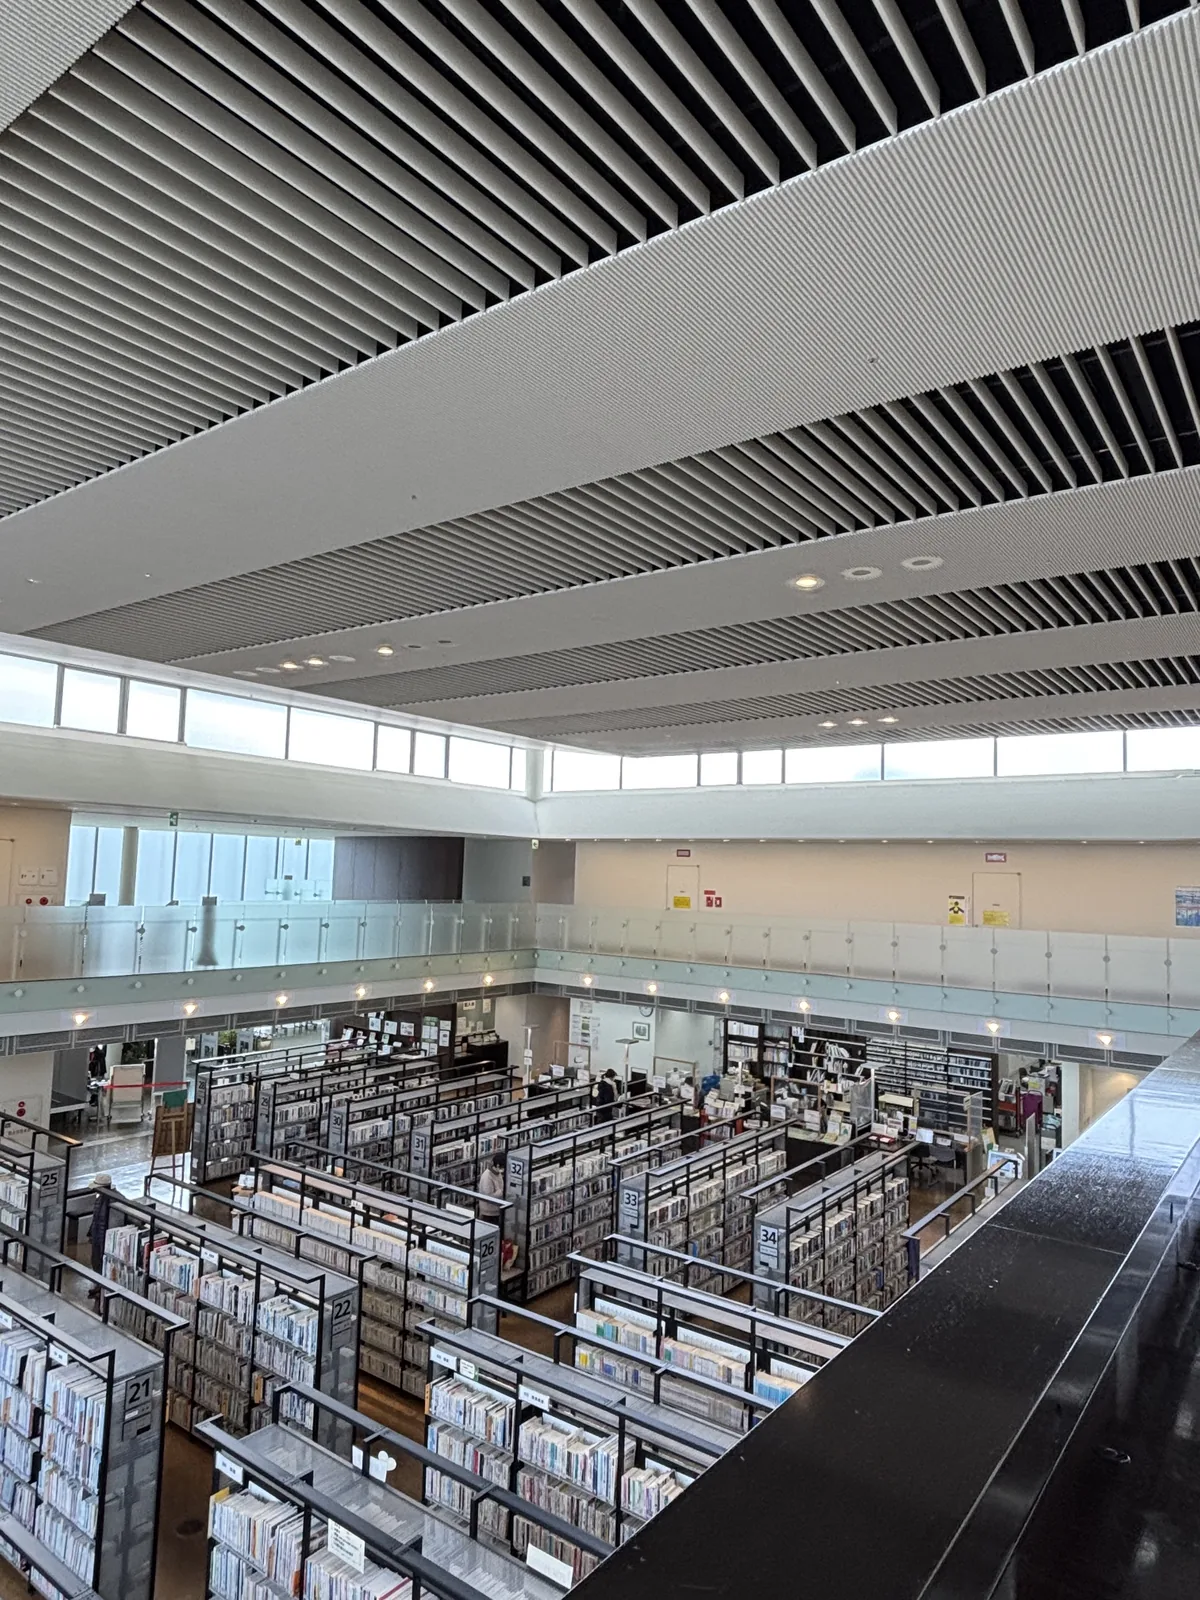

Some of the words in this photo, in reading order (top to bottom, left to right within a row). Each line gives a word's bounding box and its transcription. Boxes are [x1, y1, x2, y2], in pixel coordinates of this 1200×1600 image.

[261, 1096, 268, 1106] 29
[333, 1115, 341, 1126] 30
[415, 1138, 424, 1149] 31
[511, 1162, 522, 1175] 32
[42, 1173, 57, 1186] 25
[625, 1193, 637, 1206] 33
[761, 1229, 777, 1244] 34
[482, 1241, 494, 1257] 26
[334, 1299, 351, 1319] 22
[128, 1378, 150, 1404] 21
